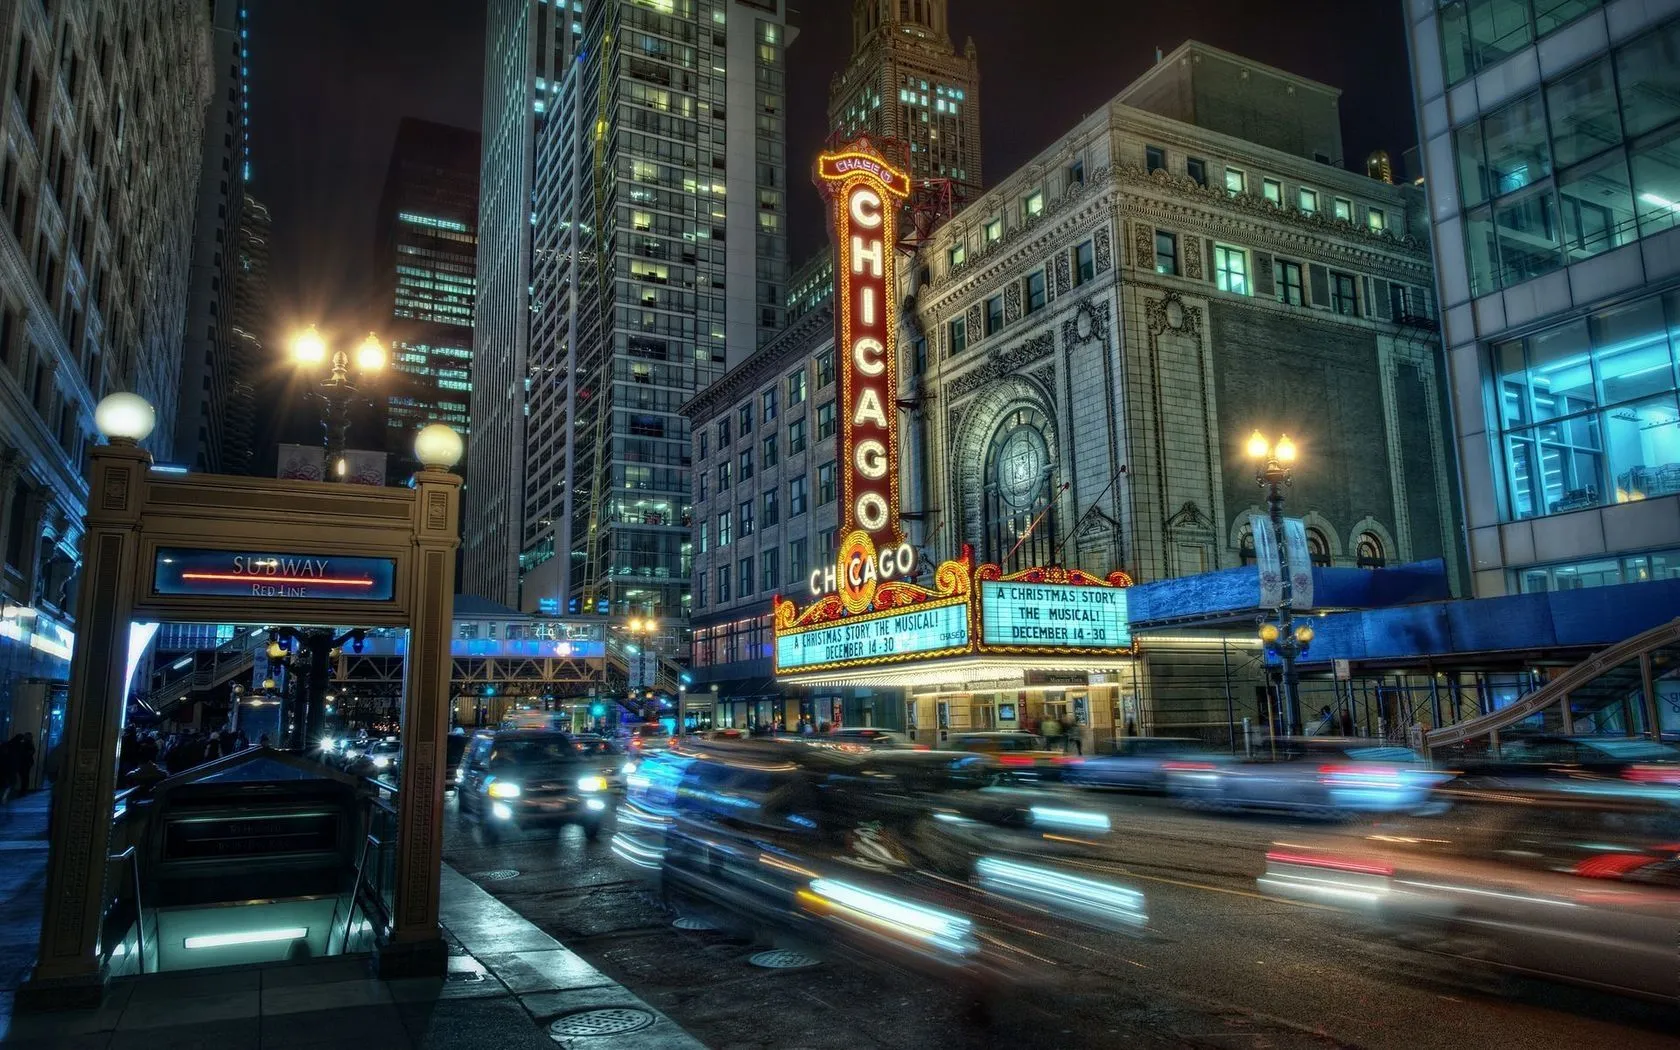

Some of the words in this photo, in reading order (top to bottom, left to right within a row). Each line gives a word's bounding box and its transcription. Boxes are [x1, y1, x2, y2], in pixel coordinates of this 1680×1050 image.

[835, 158, 881, 174] CHASE
[850, 189, 889, 531] CHICAGO
[232, 555, 329, 578] SUBWAY
[810, 543, 913, 595] CHICAGO
[997, 587, 1005, 600] A
[1011, 587, 1076, 602] CHRISTMAS
[1082, 591, 1116, 605] STORY,
[1019, 607, 1040, 620] THE
[1049, 608, 1100, 622] MUSICAL!
[794, 636, 799, 649] A
[802, 628, 841, 648] CHRISTMAS
[875, 620, 890, 637] THE
[895, 610, 938, 634] MUSICAL!
[1012, 626, 1068, 640] DECEMBER
[825, 641, 864, 660] DECEMBER
